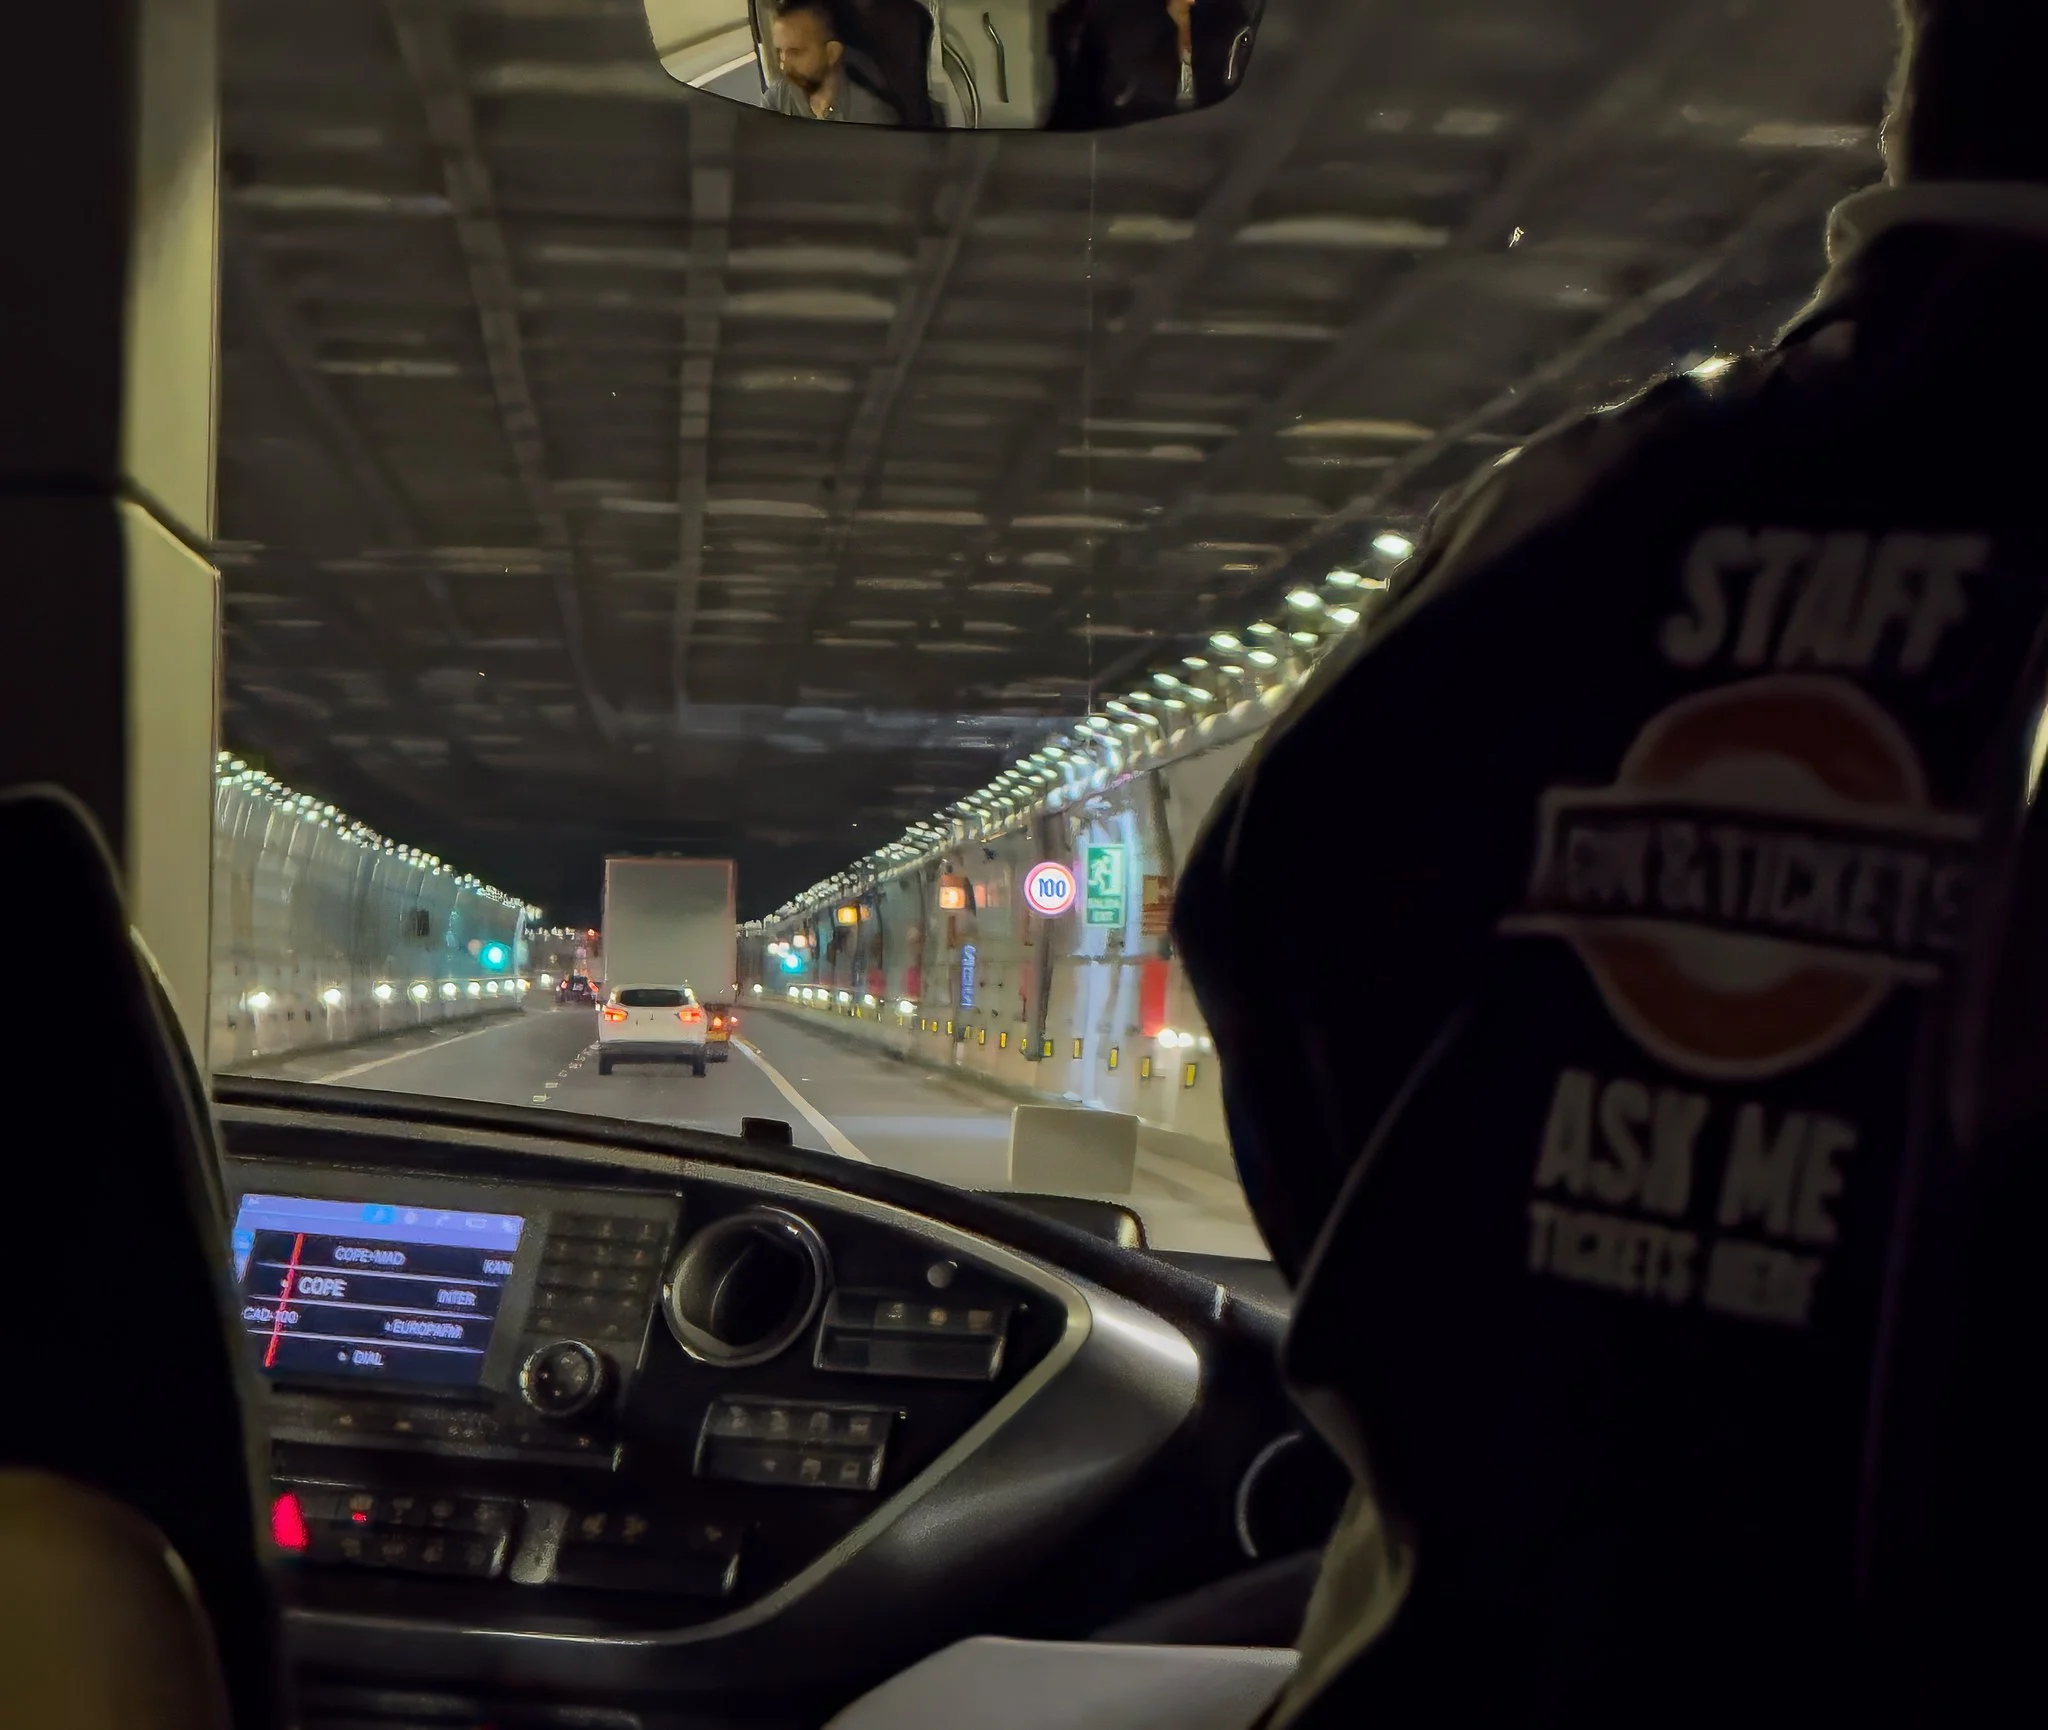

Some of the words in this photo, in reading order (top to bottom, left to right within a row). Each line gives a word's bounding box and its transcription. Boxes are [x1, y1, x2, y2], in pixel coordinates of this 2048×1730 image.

[1657, 524, 1985, 674] STAFF
[1038, 878, 1066, 898] 100
[1531, 1066, 1712, 1221] ASK
[1714, 1100, 1860, 1246] ME
[298, 1276, 347, 1297] COPE
